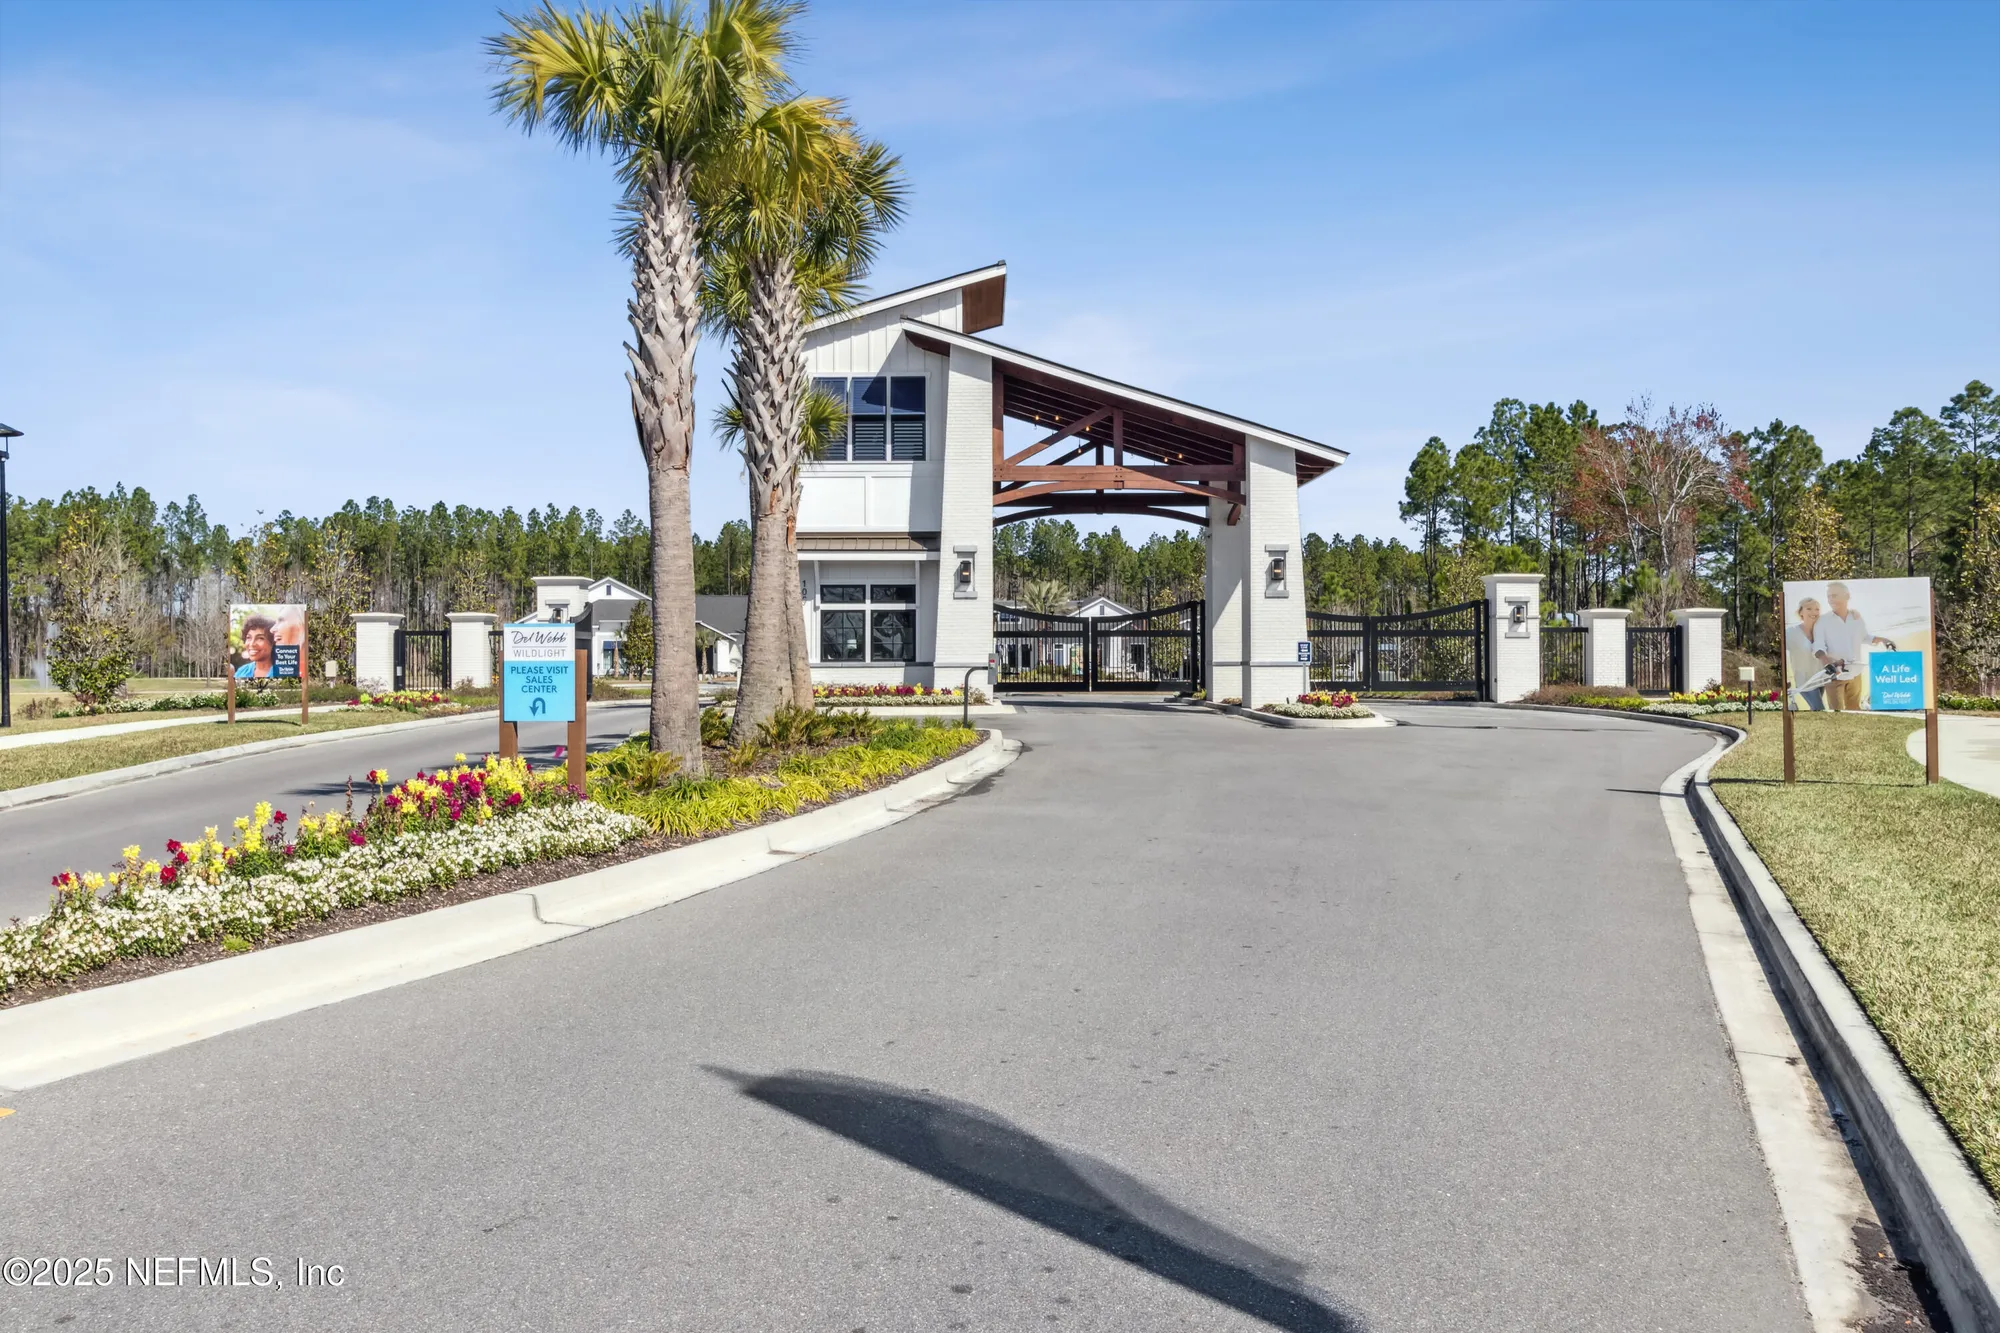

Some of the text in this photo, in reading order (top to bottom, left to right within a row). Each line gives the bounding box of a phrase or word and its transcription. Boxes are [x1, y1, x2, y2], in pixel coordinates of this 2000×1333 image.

[511, 630, 567, 645] Del Webb
[513, 649, 566, 658] WILDLIGHT
[510, 666, 569, 675] PLEASE VISIT
[1881, 665, 1910, 673] A Life
[525, 676, 554, 684] SALES
[1875, 675, 1917, 684] Well Led
[521, 685, 558, 693] CENTER
